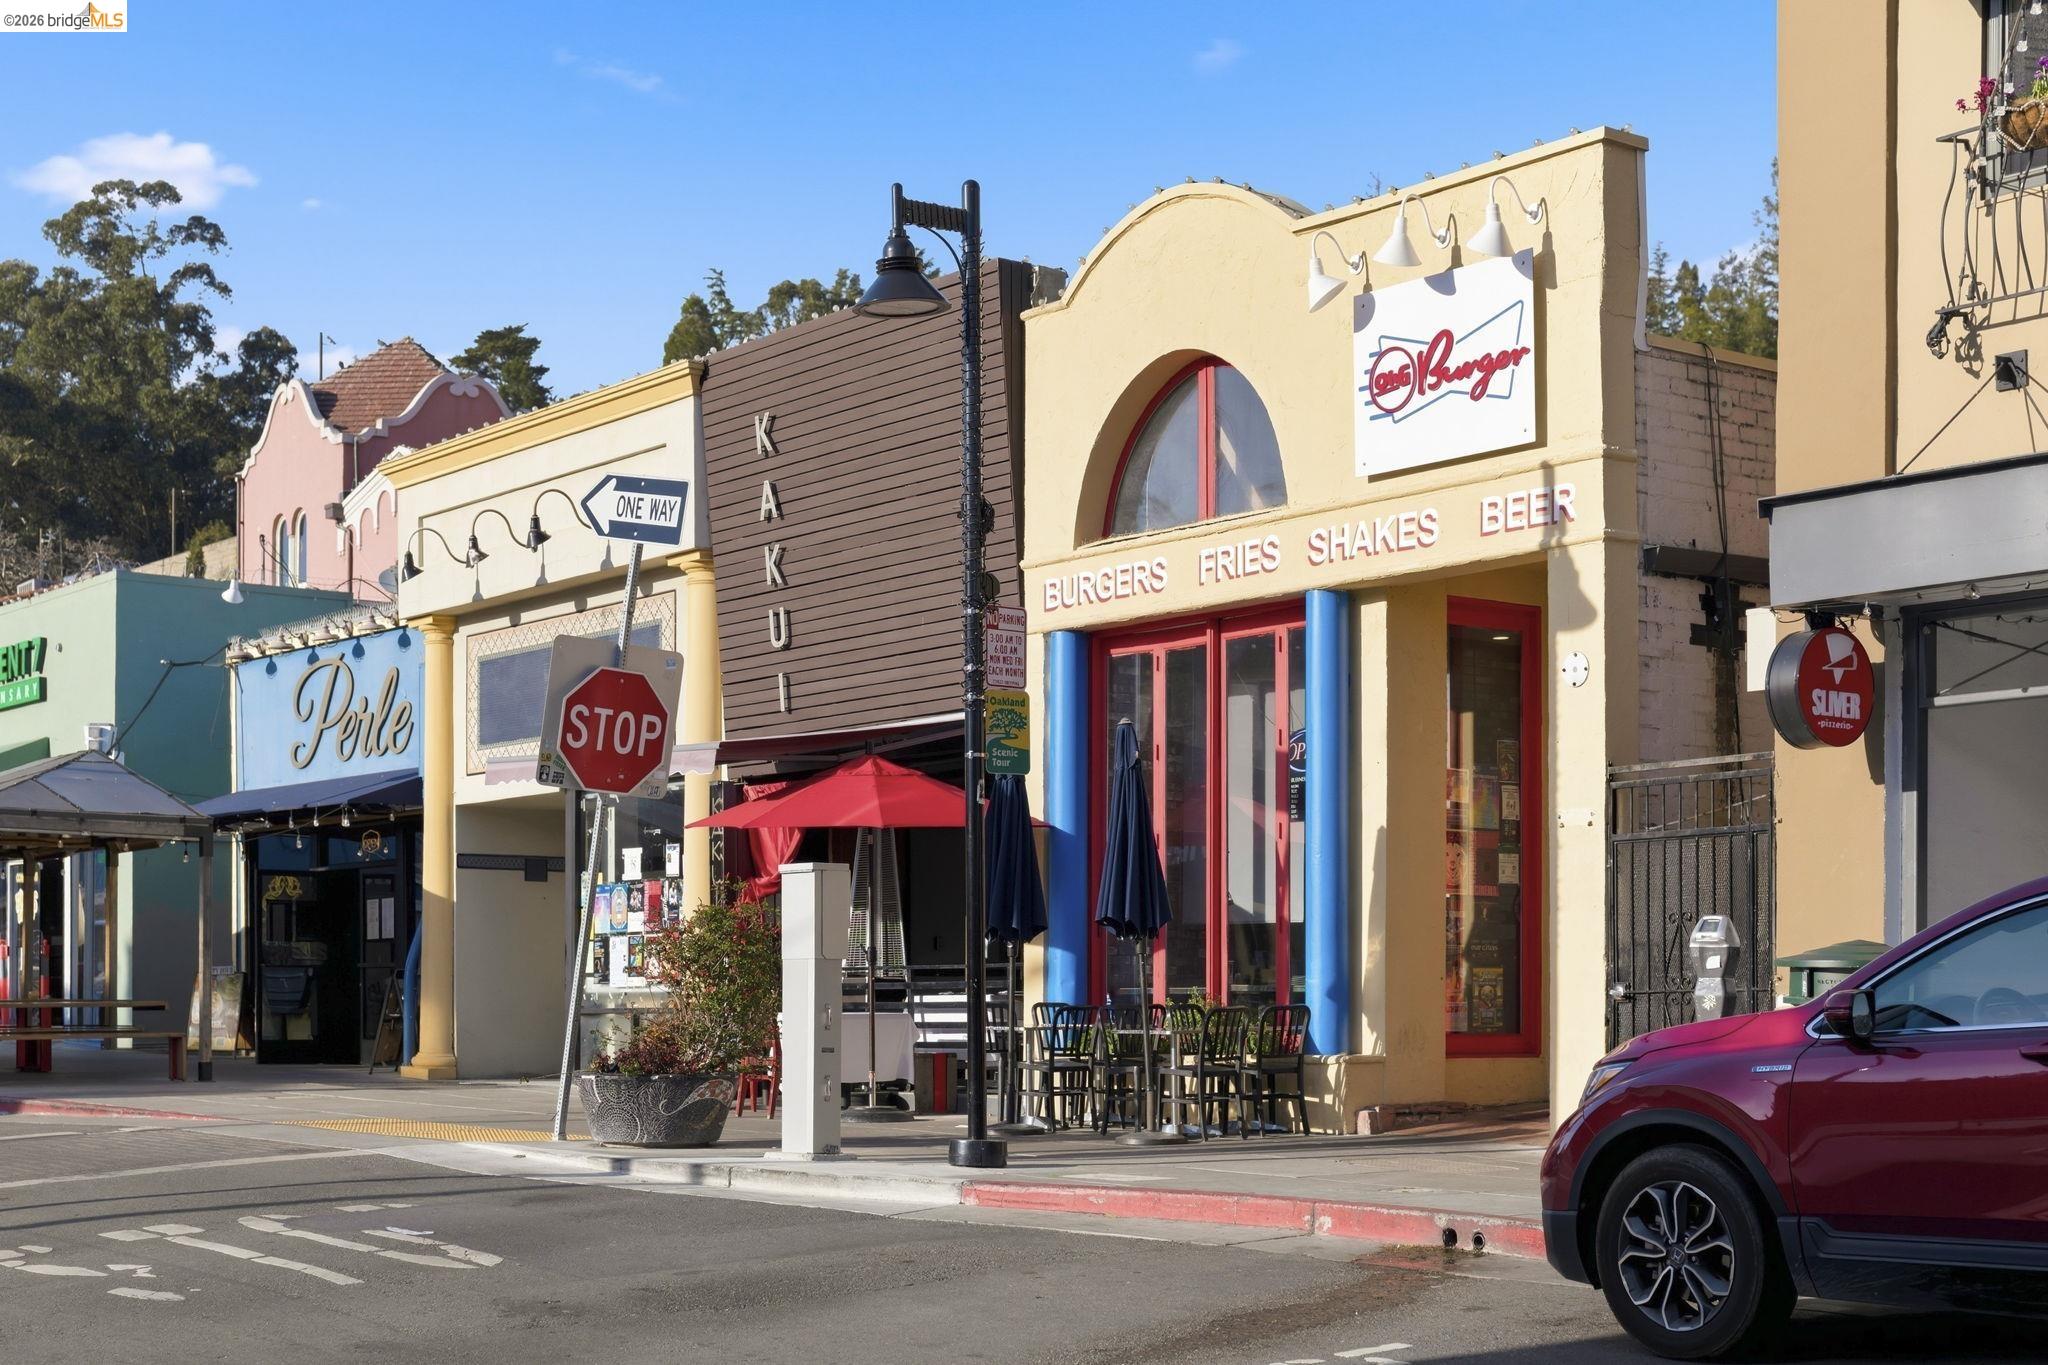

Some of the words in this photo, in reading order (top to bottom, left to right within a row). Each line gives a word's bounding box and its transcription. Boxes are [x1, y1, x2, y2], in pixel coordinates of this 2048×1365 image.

[1416, 328, 1532, 402] Burger
[616, 494, 645, 520] ONE
[649, 497, 678, 523] WAY
[1043, 555, 1169, 613] BURGERS
[1198, 533, 1281, 587] FRIES
[1307, 507, 1440, 567] SHAKES
[1480, 482, 1577, 538] BEER
[754, 411, 787, 713] KAKUI
[999, 613, 1025, 627] PARKING
[1005, 634, 1014, 644] AM
[1015, 635, 1023, 646] TO
[1009, 646, 1018, 656] AM
[989, 654, 1001, 664] MON
[988, 665, 1004, 676] EACH
[1005, 667, 1024, 678] MONTH
[989, 696, 1026, 707] Oakland
[290, 653, 414, 770] Perle
[566, 703, 663, 757] STOP
[991, 747, 1019, 757] Scenic
[991, 758, 1011, 767] Tour
